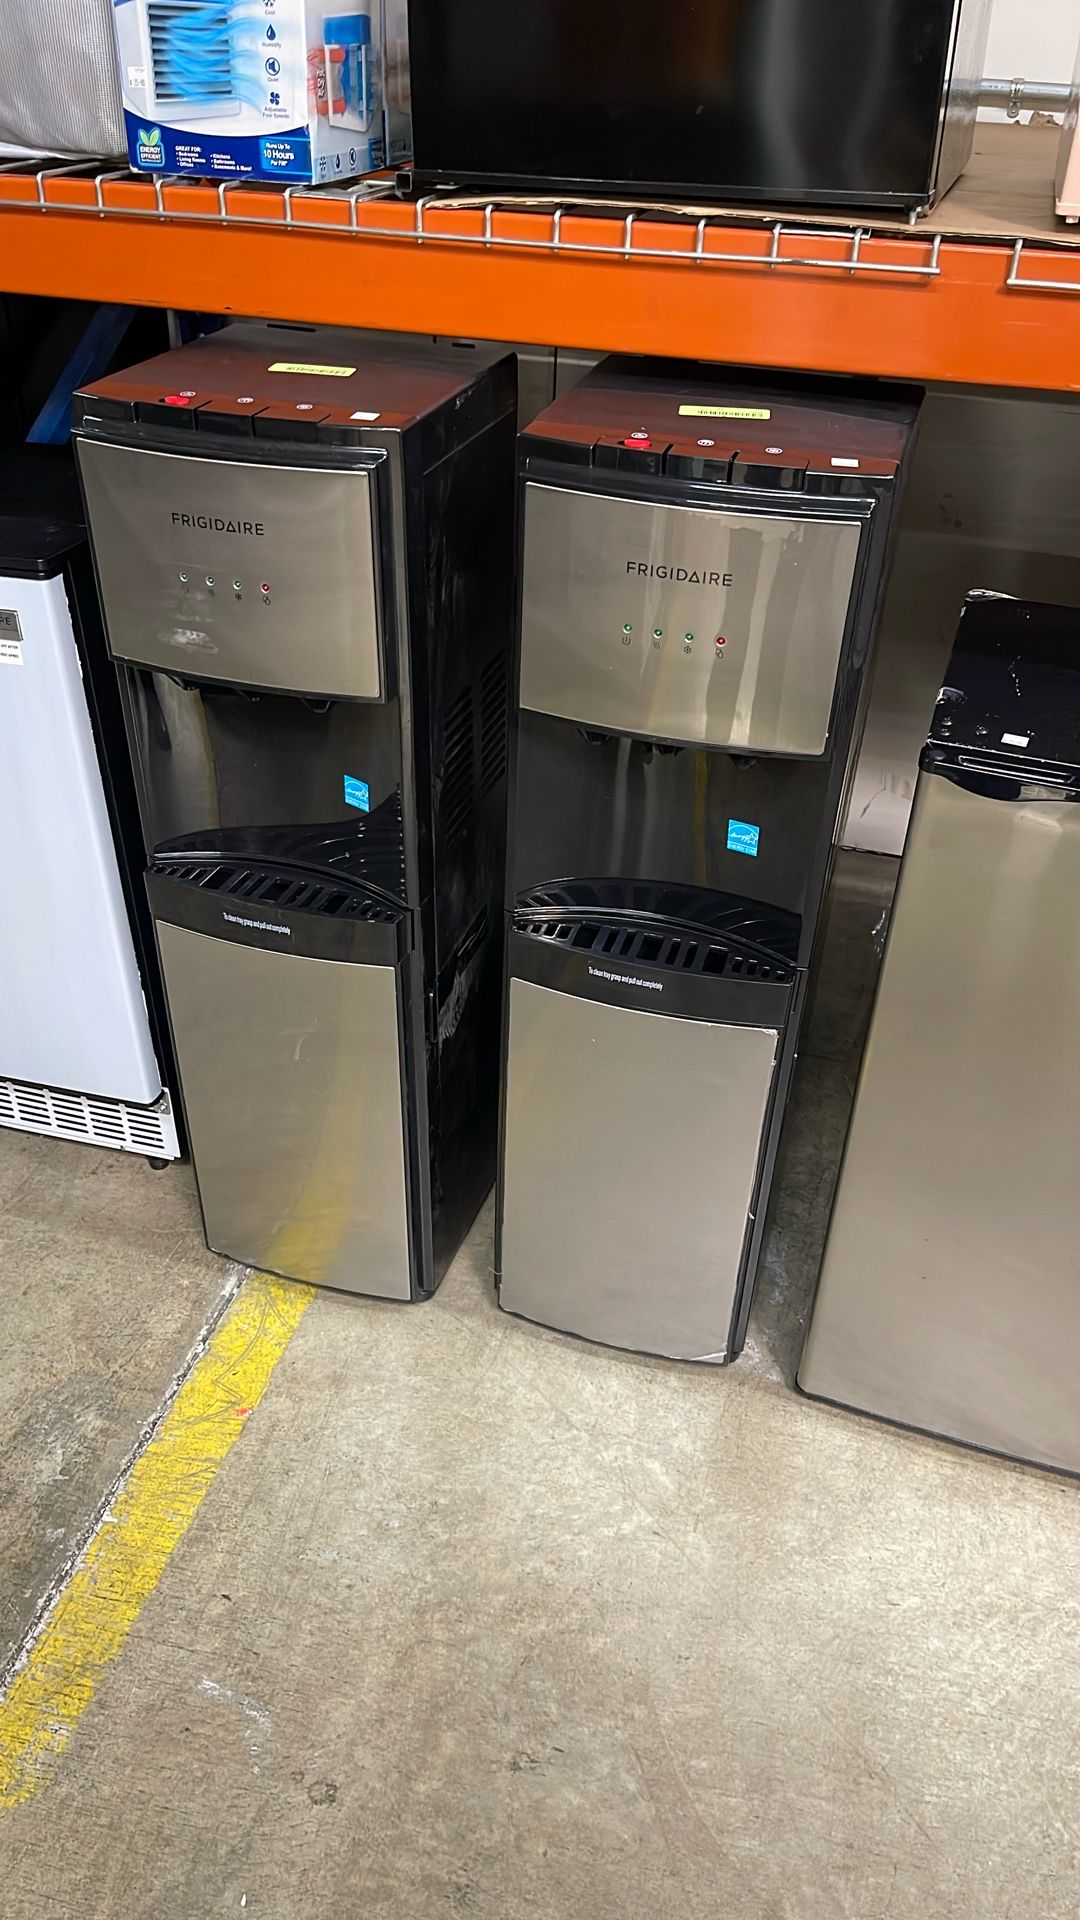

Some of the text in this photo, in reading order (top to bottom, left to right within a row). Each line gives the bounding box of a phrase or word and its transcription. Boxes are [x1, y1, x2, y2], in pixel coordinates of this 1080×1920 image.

[140, 146, 160, 154] ENERGY
[263, 150, 295, 160] 10 Hours
[171, 512, 264, 536] FRIGIDAIRE
[626, 561, 733, 587] FRIGIDAIRE
[588, 966, 593, 975] To
[593, 969, 603, 977] clean
[603, 971, 611, 980] tray
[642, 980, 663, 991] completely
